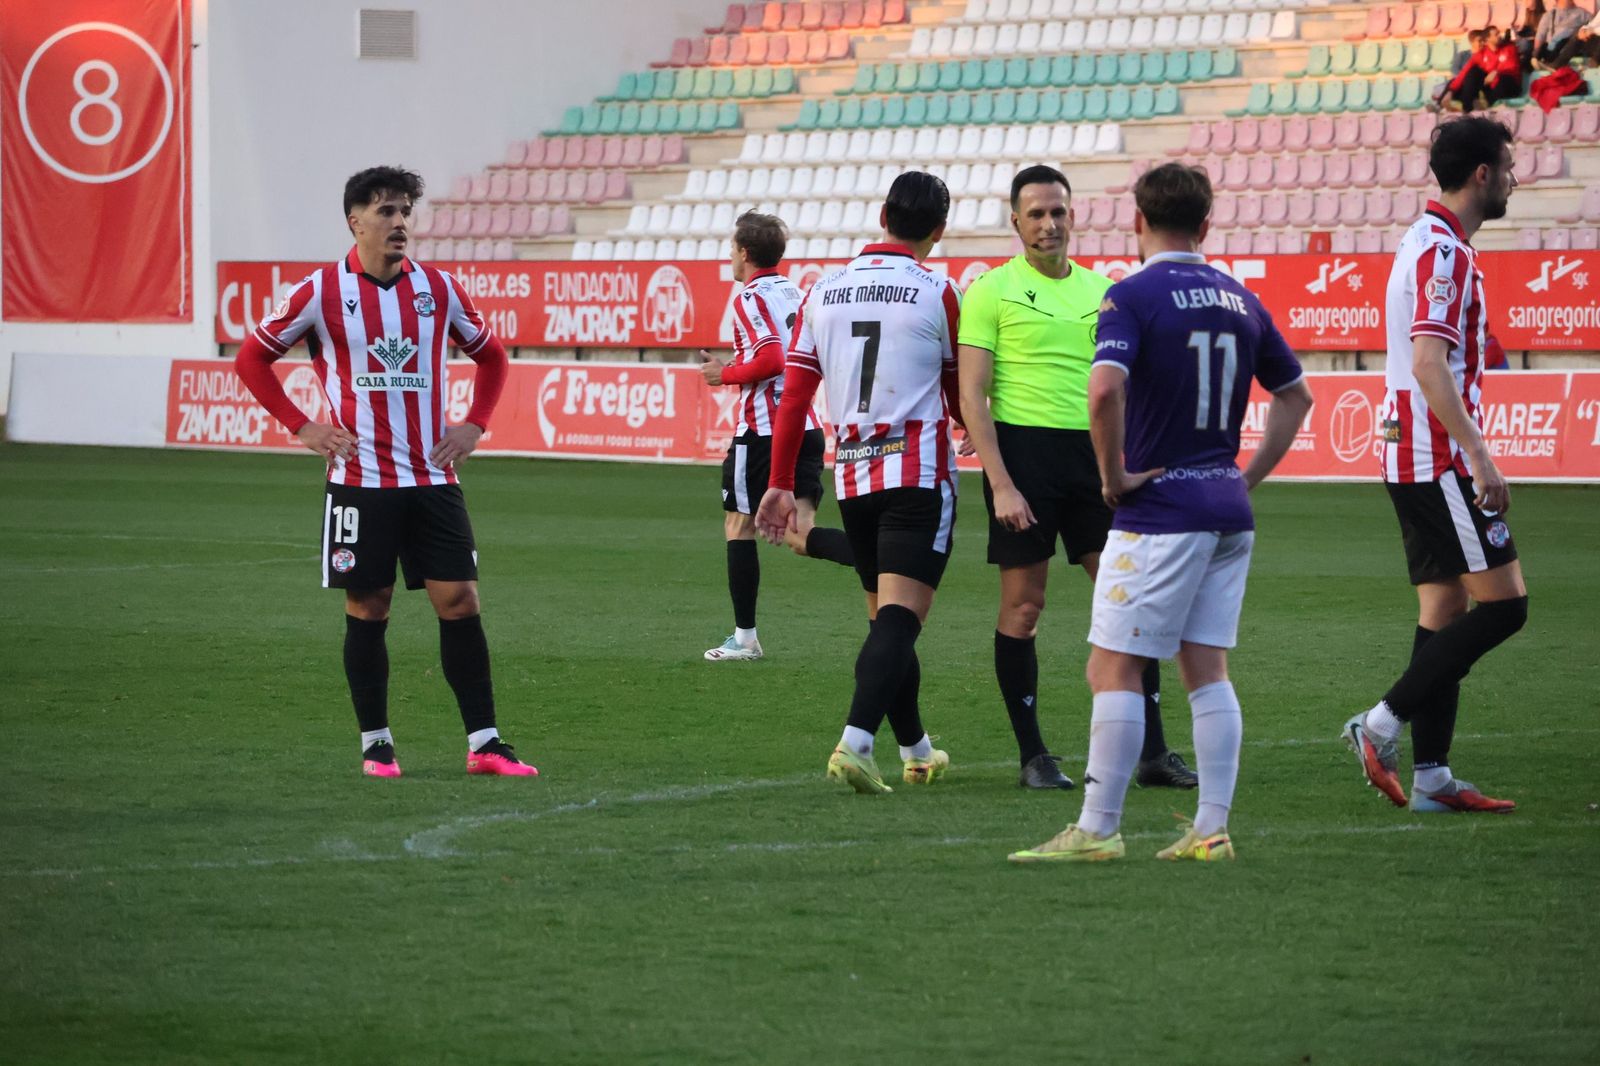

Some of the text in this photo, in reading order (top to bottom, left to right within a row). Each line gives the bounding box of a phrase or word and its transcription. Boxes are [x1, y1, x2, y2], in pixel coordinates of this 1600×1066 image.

[70, 60, 122, 145] 8
[454, 266, 531, 298] biex.es
[544, 265, 638, 302] FUNDACIÓN
[822, 287, 853, 306] KIKE
[855, 280, 920, 304] MÁRQUEZ
[1171, 287, 1248, 316] U.EULATE
[1288, 301, 1380, 336] sangregorio
[356, 376, 428, 389] CAJA RURAL
[851, 321, 881, 413] 7
[1187, 331, 1239, 431] 11
[180, 370, 256, 403] FUNDAC
[562, 368, 676, 428] Freigel
[1481, 403, 1561, 437] VAREZ
[332, 505, 359, 544] 19
